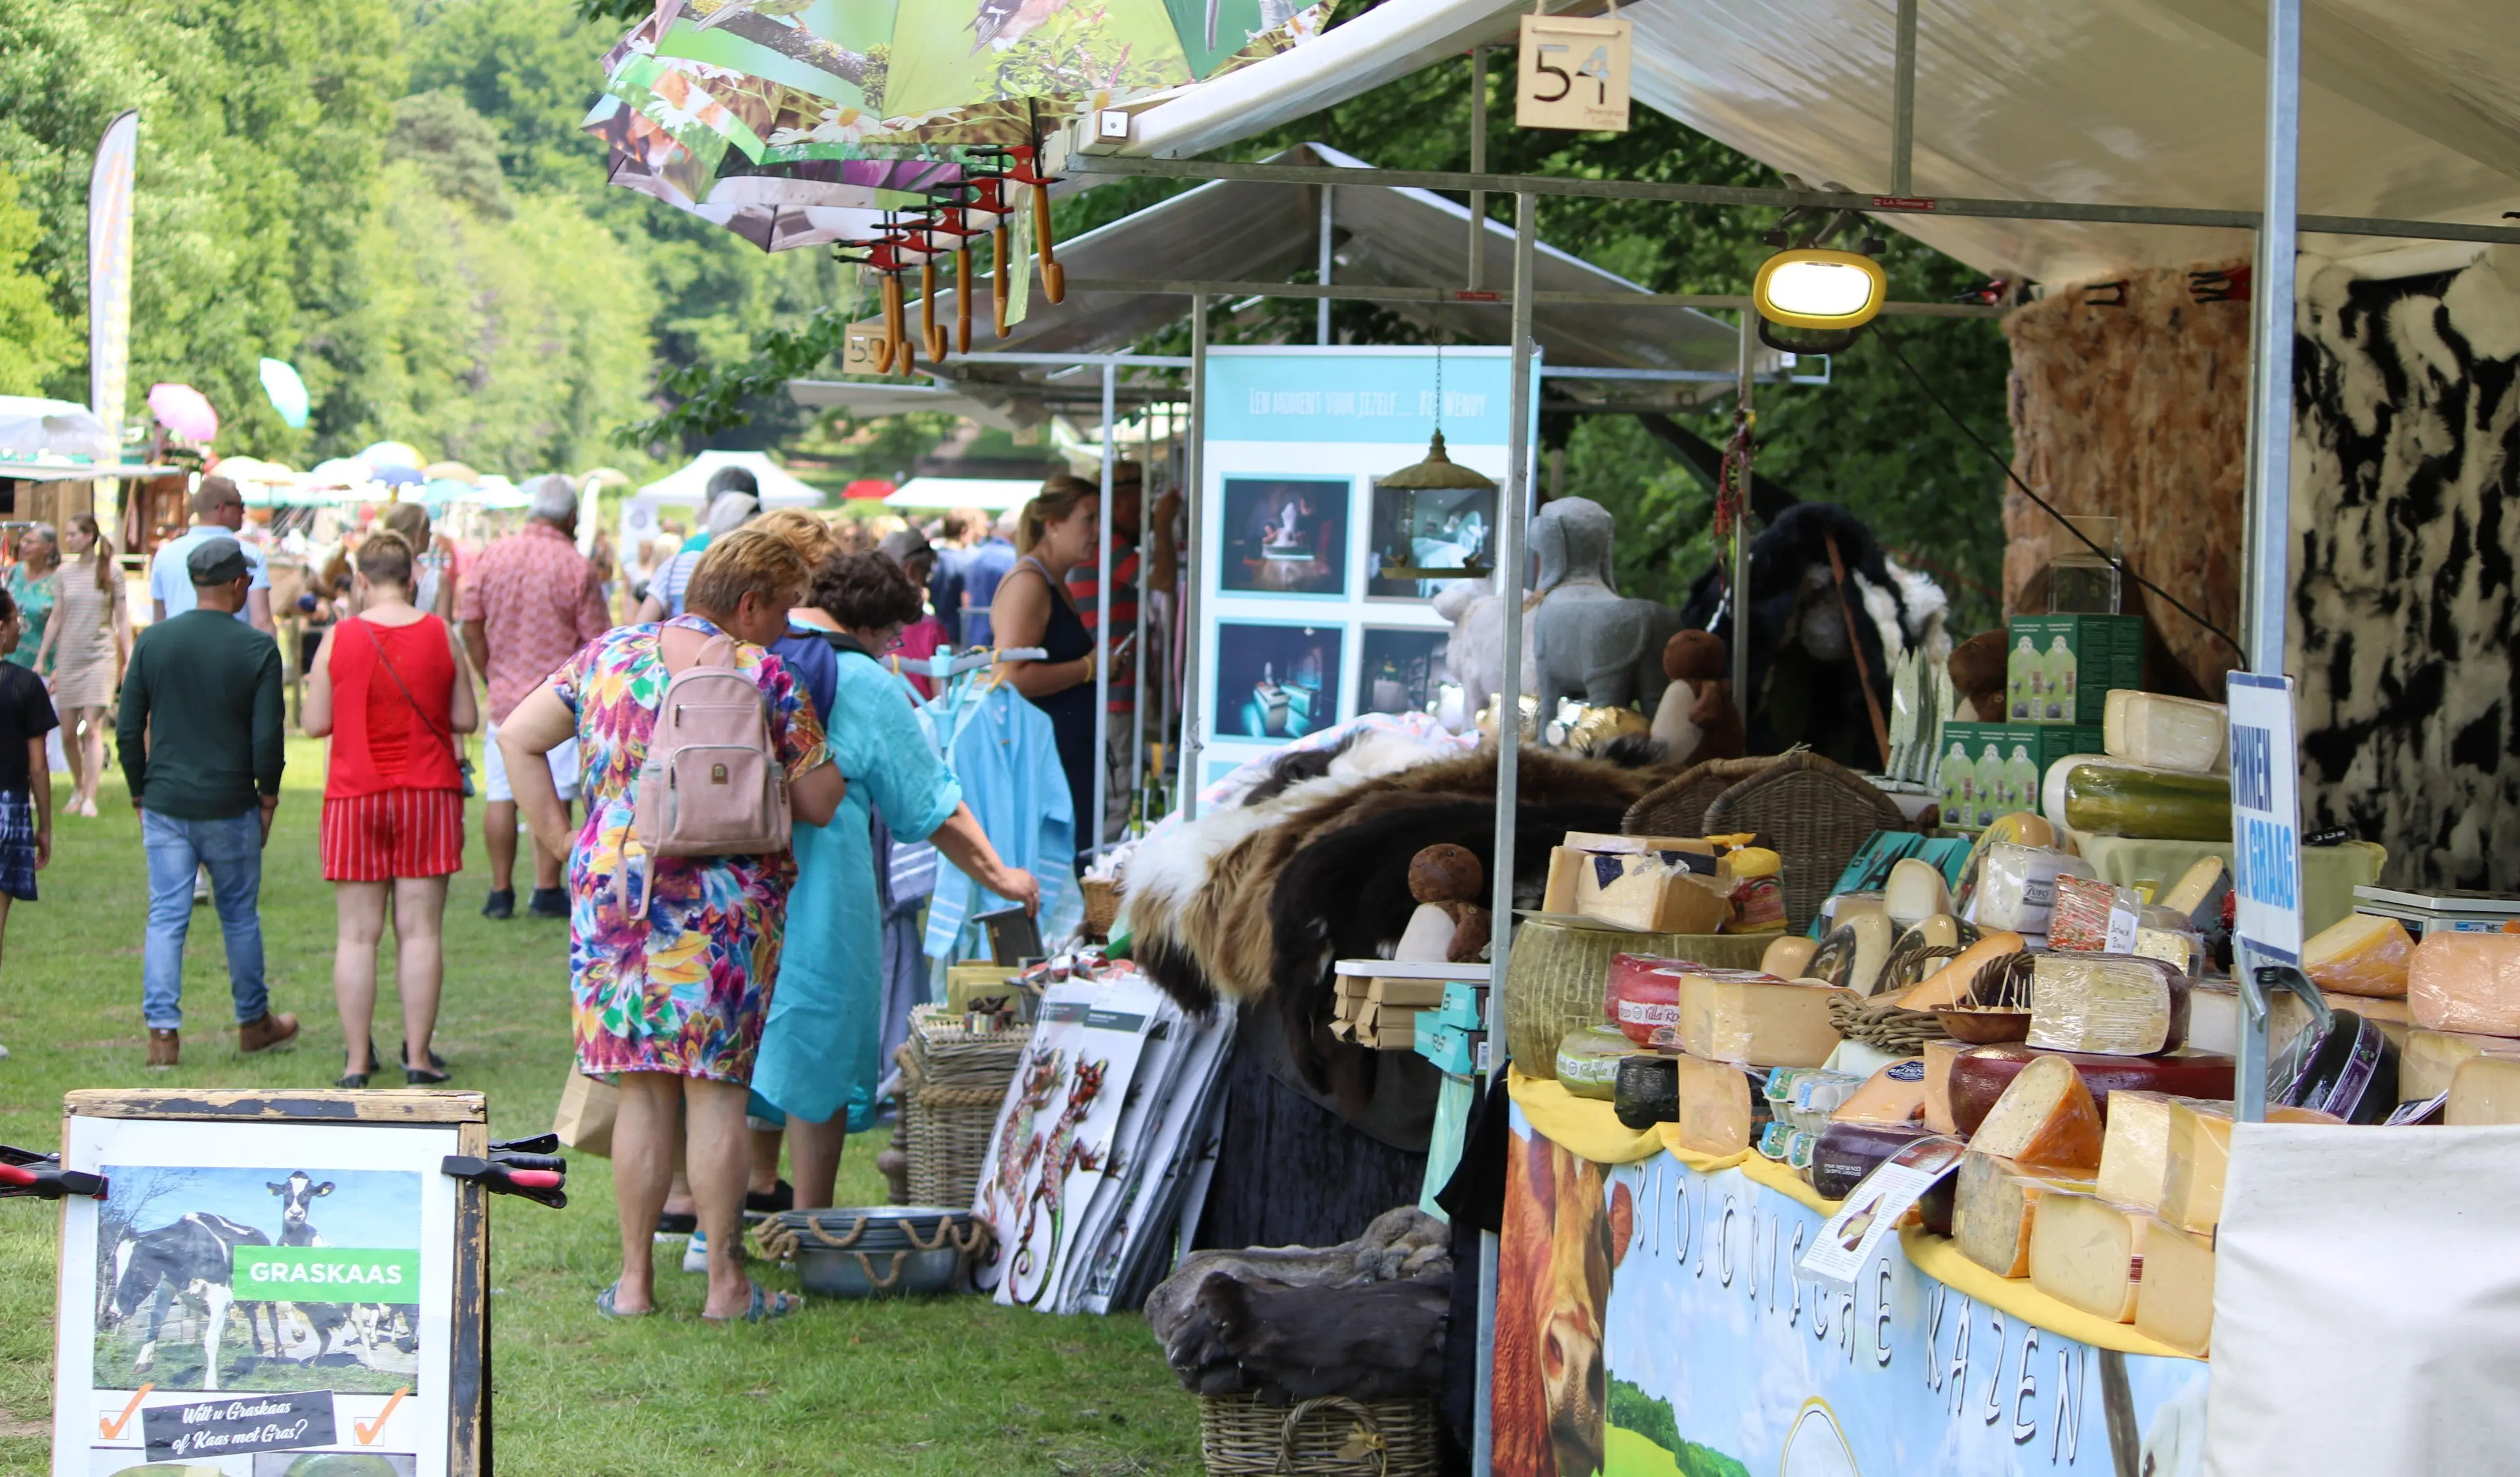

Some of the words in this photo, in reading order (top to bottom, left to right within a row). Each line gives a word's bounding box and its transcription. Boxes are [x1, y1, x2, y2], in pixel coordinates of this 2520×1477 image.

[1534, 44, 1610, 104] 54
[2231, 723, 2272, 813] PINNEN
[2235, 815, 2249, 898] JA
[2250, 818, 2296, 911] GRAAG
[249, 1262, 402, 1285] GRASKAAS
[1926, 1282, 2085, 1467] KAZEN
[171, 1432, 191, 1455] of
[192, 1430, 230, 1449] Kaas
[231, 1426, 261, 1444] met
[261, 1418, 308, 1442] Gras?
[182, 1403, 213, 1424] Wilt
[213, 1409, 225, 1420] u
[226, 1400, 292, 1421] Graskaas
